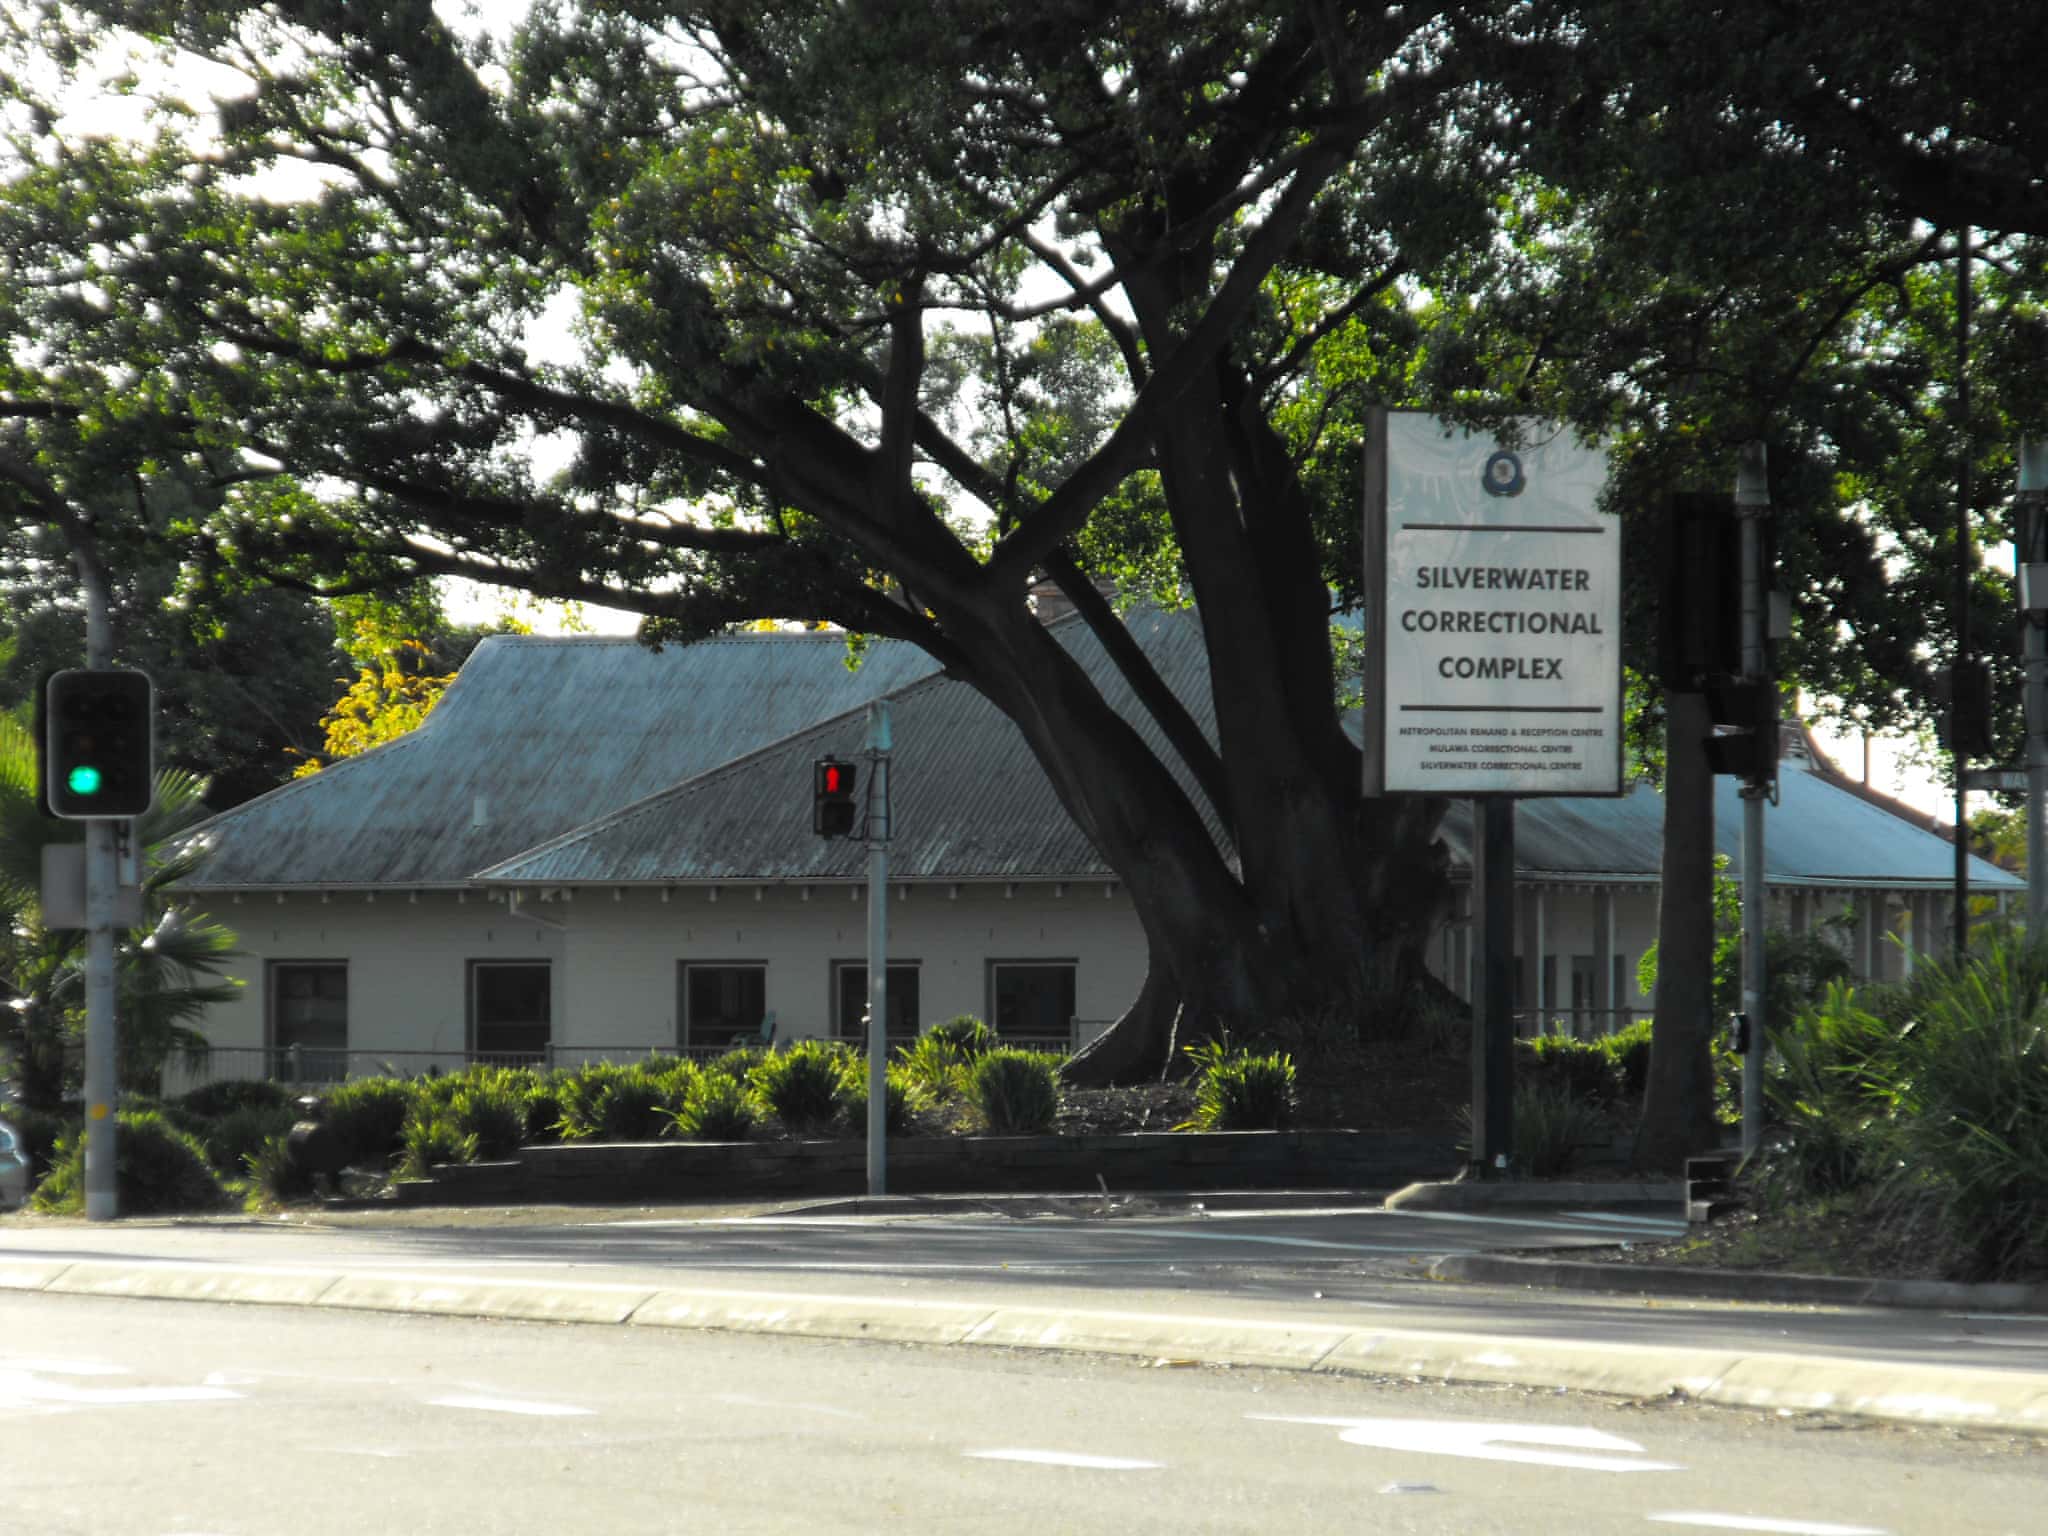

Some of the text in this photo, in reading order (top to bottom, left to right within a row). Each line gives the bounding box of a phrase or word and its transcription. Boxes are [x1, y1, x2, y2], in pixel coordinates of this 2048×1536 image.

[1416, 566, 1590, 592] SILVERWATER
[1401, 610, 1602, 635] CORRECTIONAL
[1438, 656, 1563, 680] COMPLEX
[1399, 727, 1467, 737] METROPOLITAN
[1470, 727, 1508, 737] REMAND
[1520, 728, 1569, 737] RECEPTION
[1571, 728, 1604, 737] CENTRE
